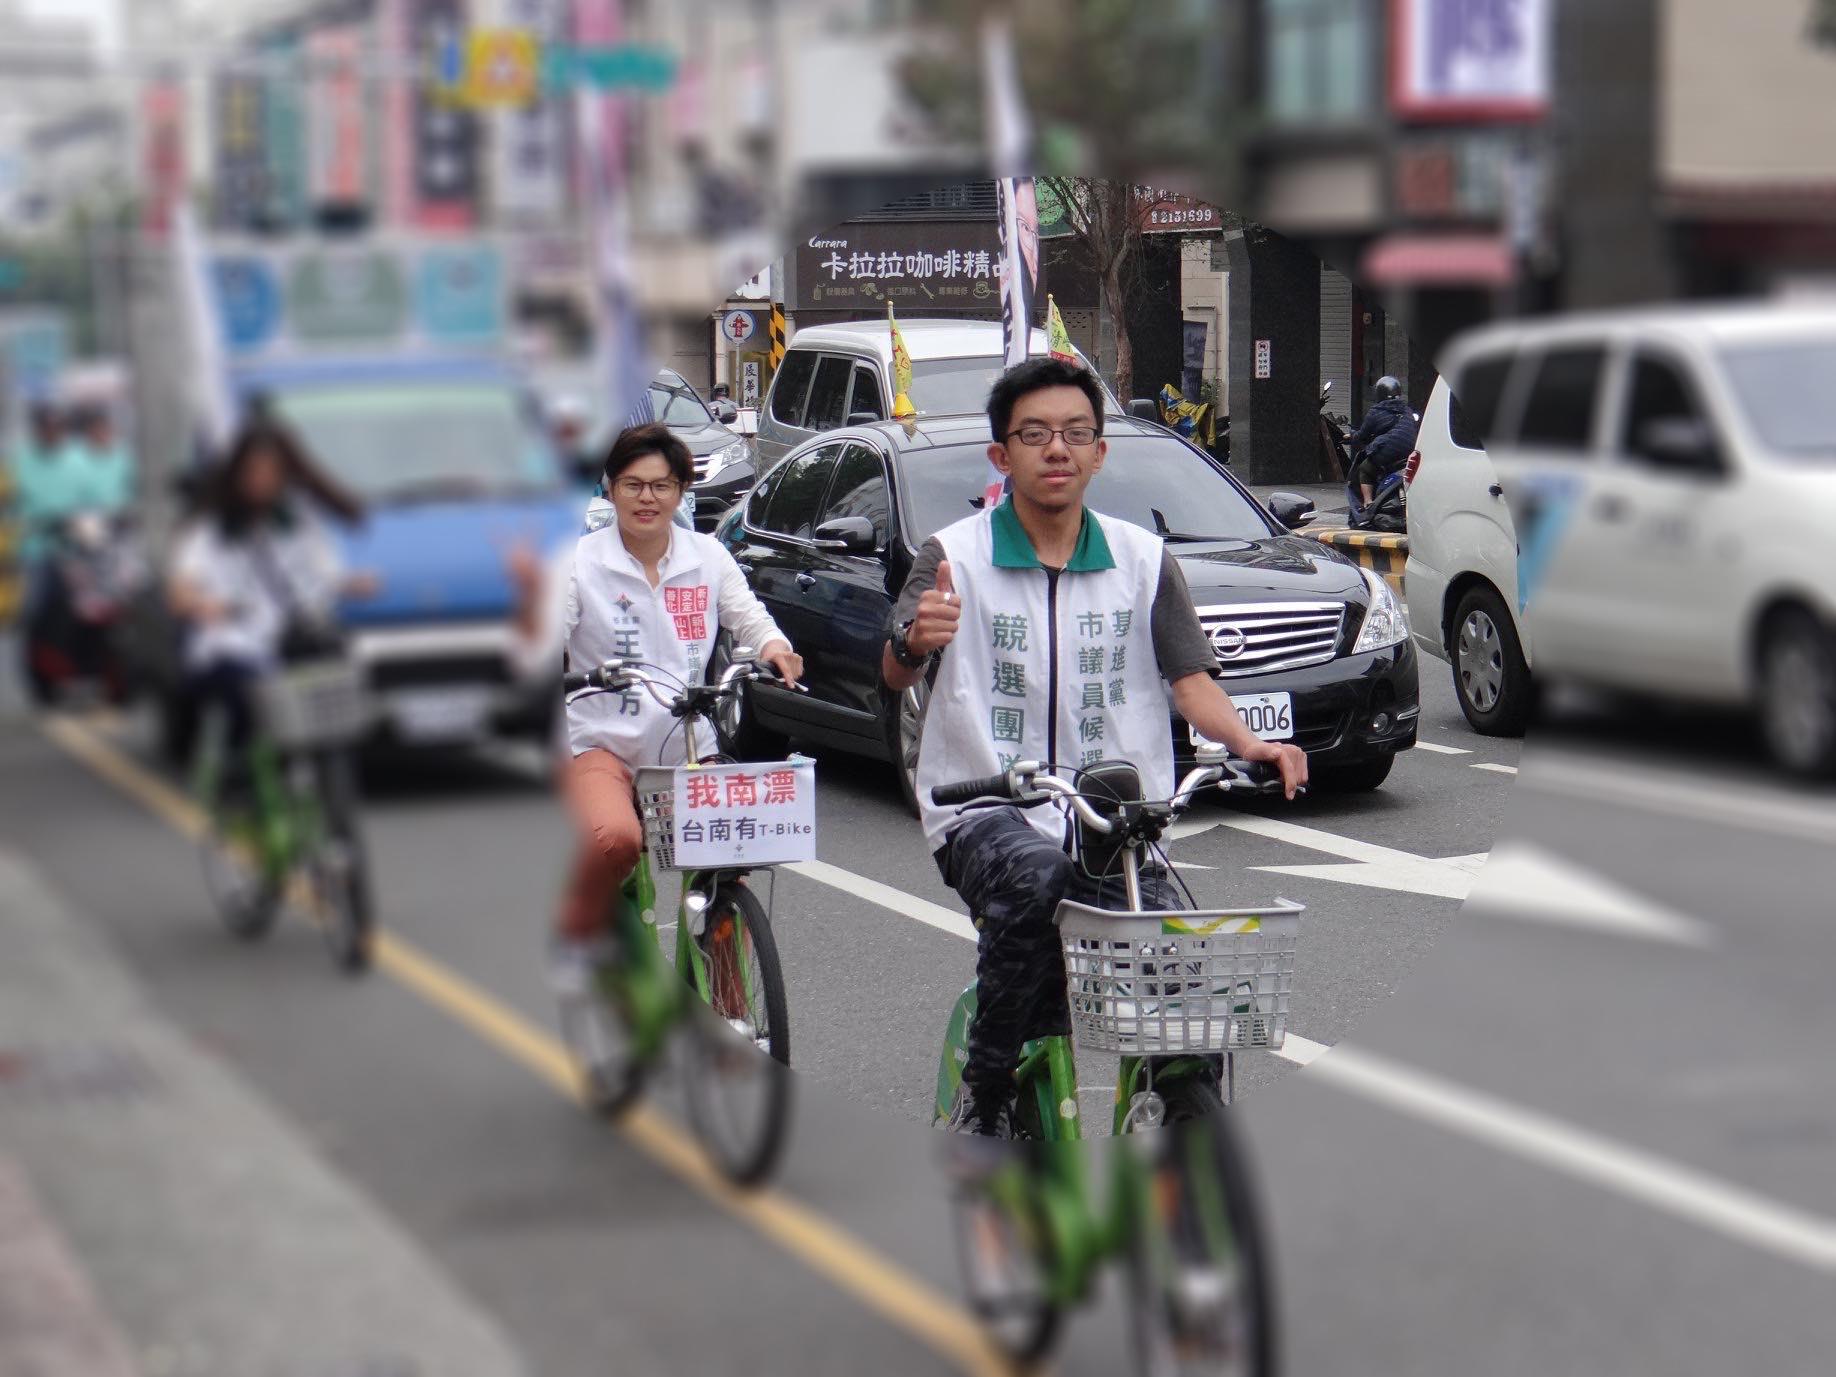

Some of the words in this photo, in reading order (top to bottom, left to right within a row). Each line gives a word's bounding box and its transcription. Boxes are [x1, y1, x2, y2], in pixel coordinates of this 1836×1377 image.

[808, 236, 848, 249] Carrara
[1109, 609, 1134, 707] 基進黨
[1213, 636, 1245, 646] NISSAN
[613, 629, 644, 716] 王方
[686, 769, 797, 810] 我南漂
